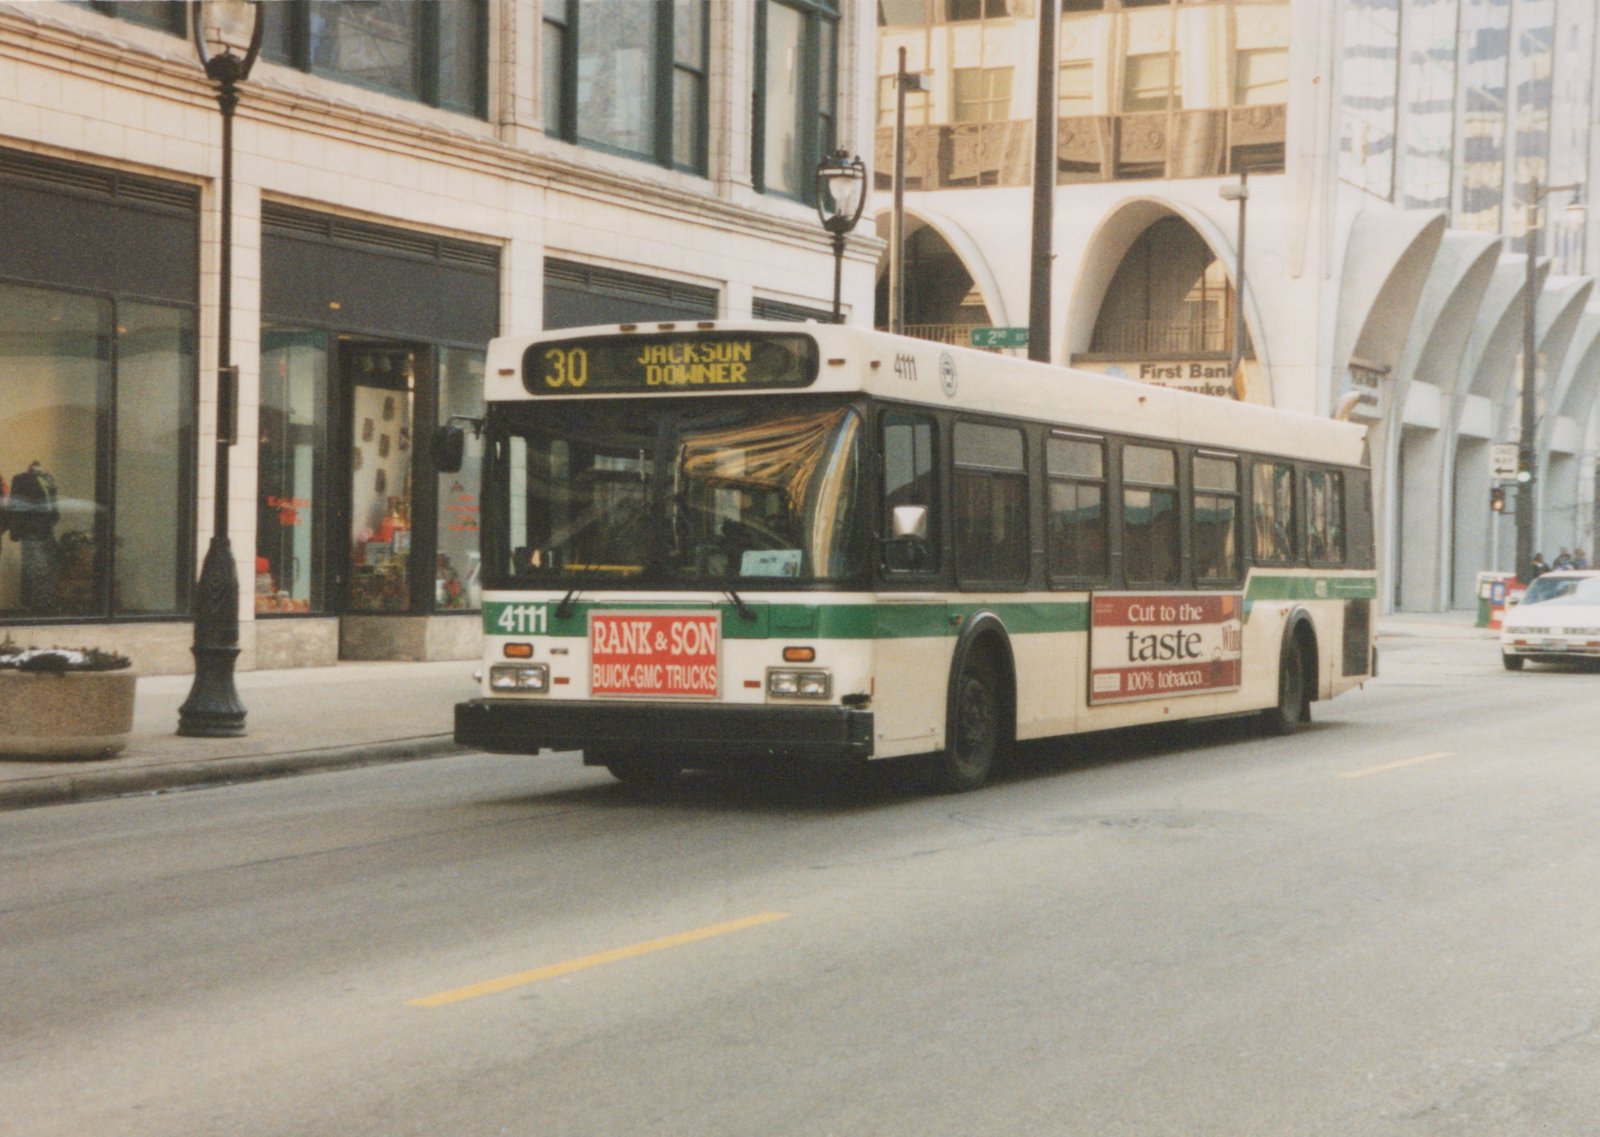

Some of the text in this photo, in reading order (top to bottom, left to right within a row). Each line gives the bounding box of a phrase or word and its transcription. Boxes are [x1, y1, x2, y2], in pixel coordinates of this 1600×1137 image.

[638, 341, 752, 365] JACKSON
[545, 348, 588, 387] 30
[646, 362, 747, 386] DOWNER
[894, 353, 917, 381] 4111
[1140, 363, 1182, 379] First
[498, 604, 547, 633] 4111
[1127, 603, 1155, 622] Cut
[1160, 605, 1176, 622] to
[1179, 603, 1203, 621] the
[593, 621, 717, 656] RANK & SON
[1126, 629, 1203, 663] taste
[666, 664, 717, 690] TRUCKS
[1127, 672, 1155, 691] 100%
